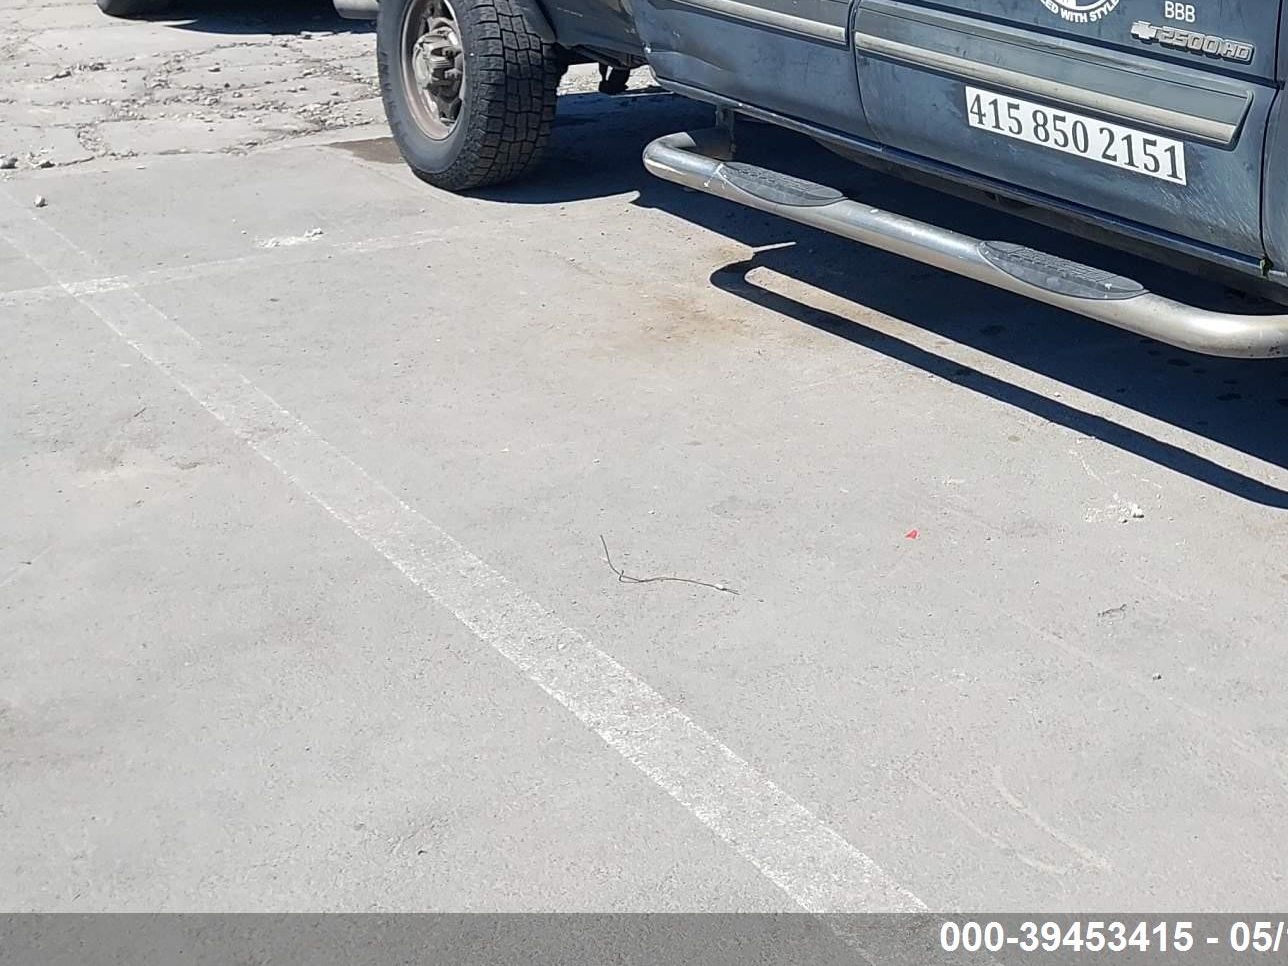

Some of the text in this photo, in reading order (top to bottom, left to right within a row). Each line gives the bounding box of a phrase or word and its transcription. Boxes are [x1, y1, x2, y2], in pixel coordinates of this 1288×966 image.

[1060, 8, 1088, 23] WITH
[1164, 0, 1196, 23] BBB
[970, 94, 1184, 181] 415 850 2151
